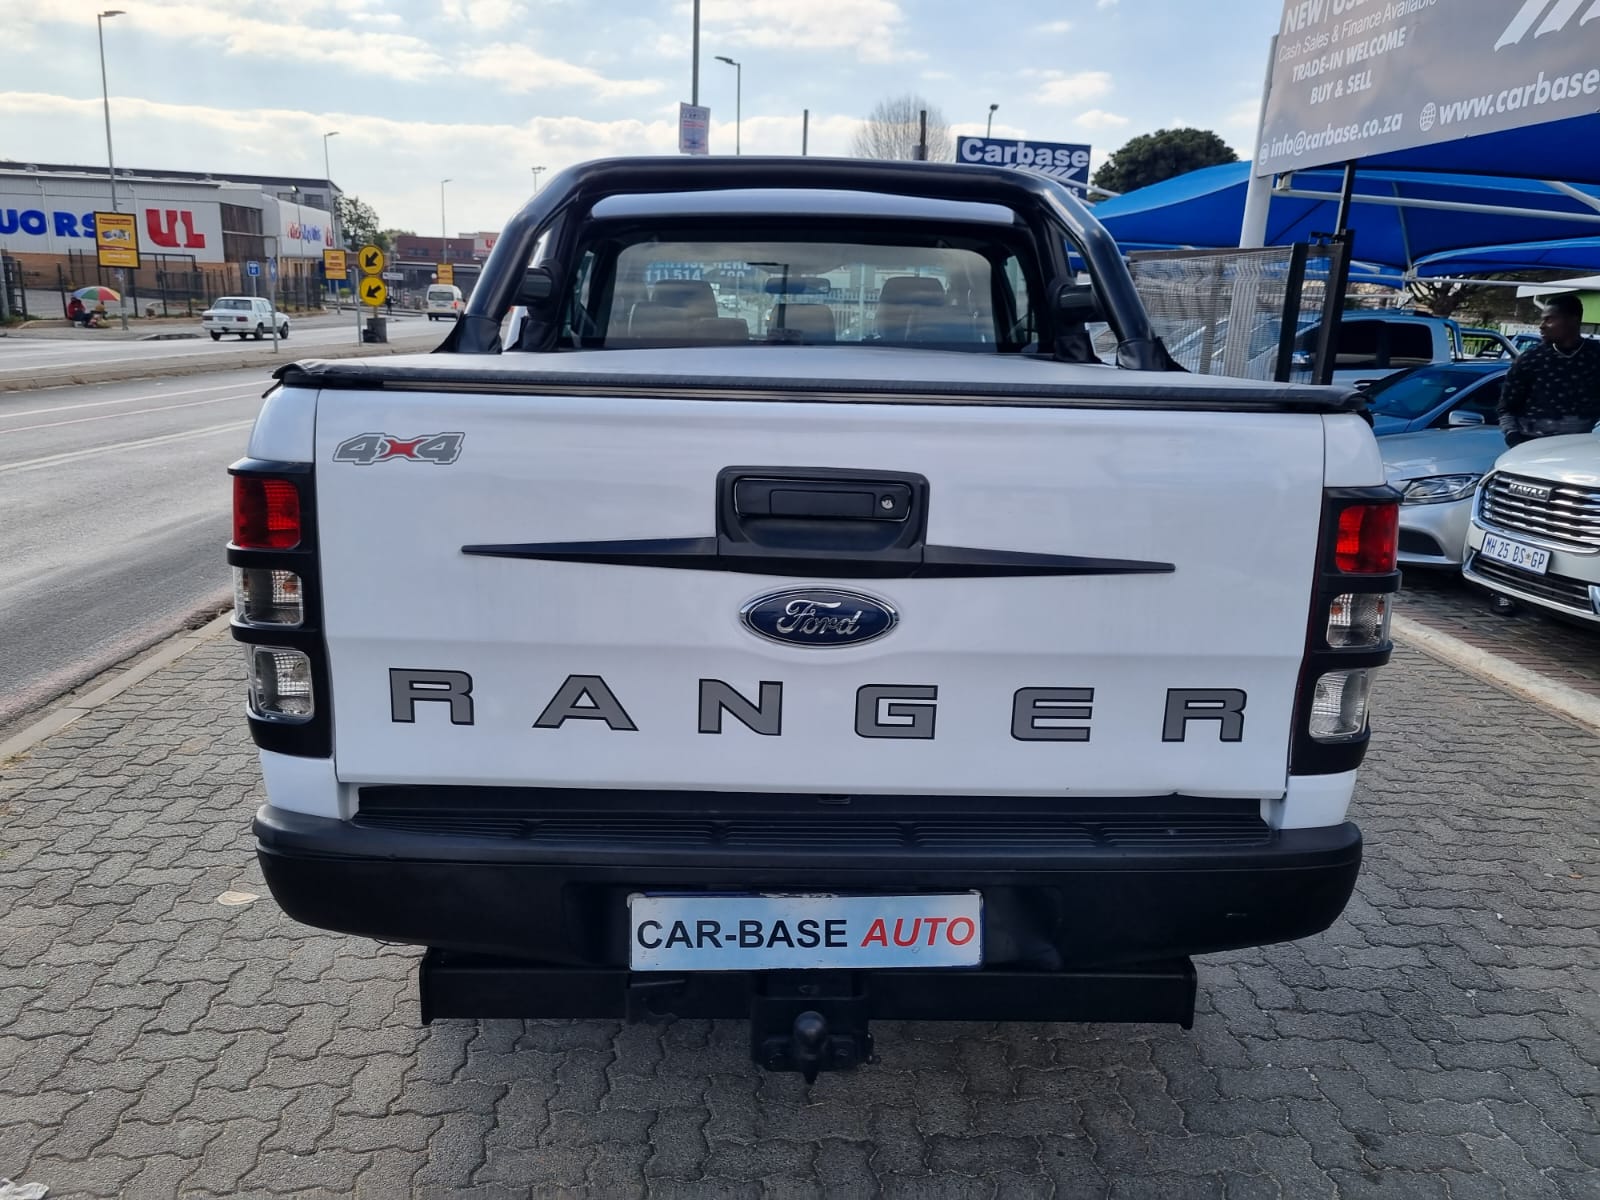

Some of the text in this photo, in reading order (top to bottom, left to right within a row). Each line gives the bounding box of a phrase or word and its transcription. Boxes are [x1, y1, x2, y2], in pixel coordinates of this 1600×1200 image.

[1283, 0, 1324, 35] NEW
[1278, 43, 1301, 62] Cash
[1303, 32, 1329, 53] Sales
[1331, 25, 1339, 43] &
[1341, 13, 1382, 40] Finance
[1292, 26, 1407, 82] TRADE-IN WELCOME
[1310, 69, 1372, 105] BUY & SELL
[961, 138, 1089, 168] Carbase
[1270, 113, 1403, 158] info@carbase.co.za
[146, 208, 206, 249] UL
[1485, 537, 1545, 569] MH 25 BS GP
[776, 599, 864, 634] Ford
[389, 667, 1248, 742] RANGER
[637, 917, 976, 949] CAR-BASE AUTO
